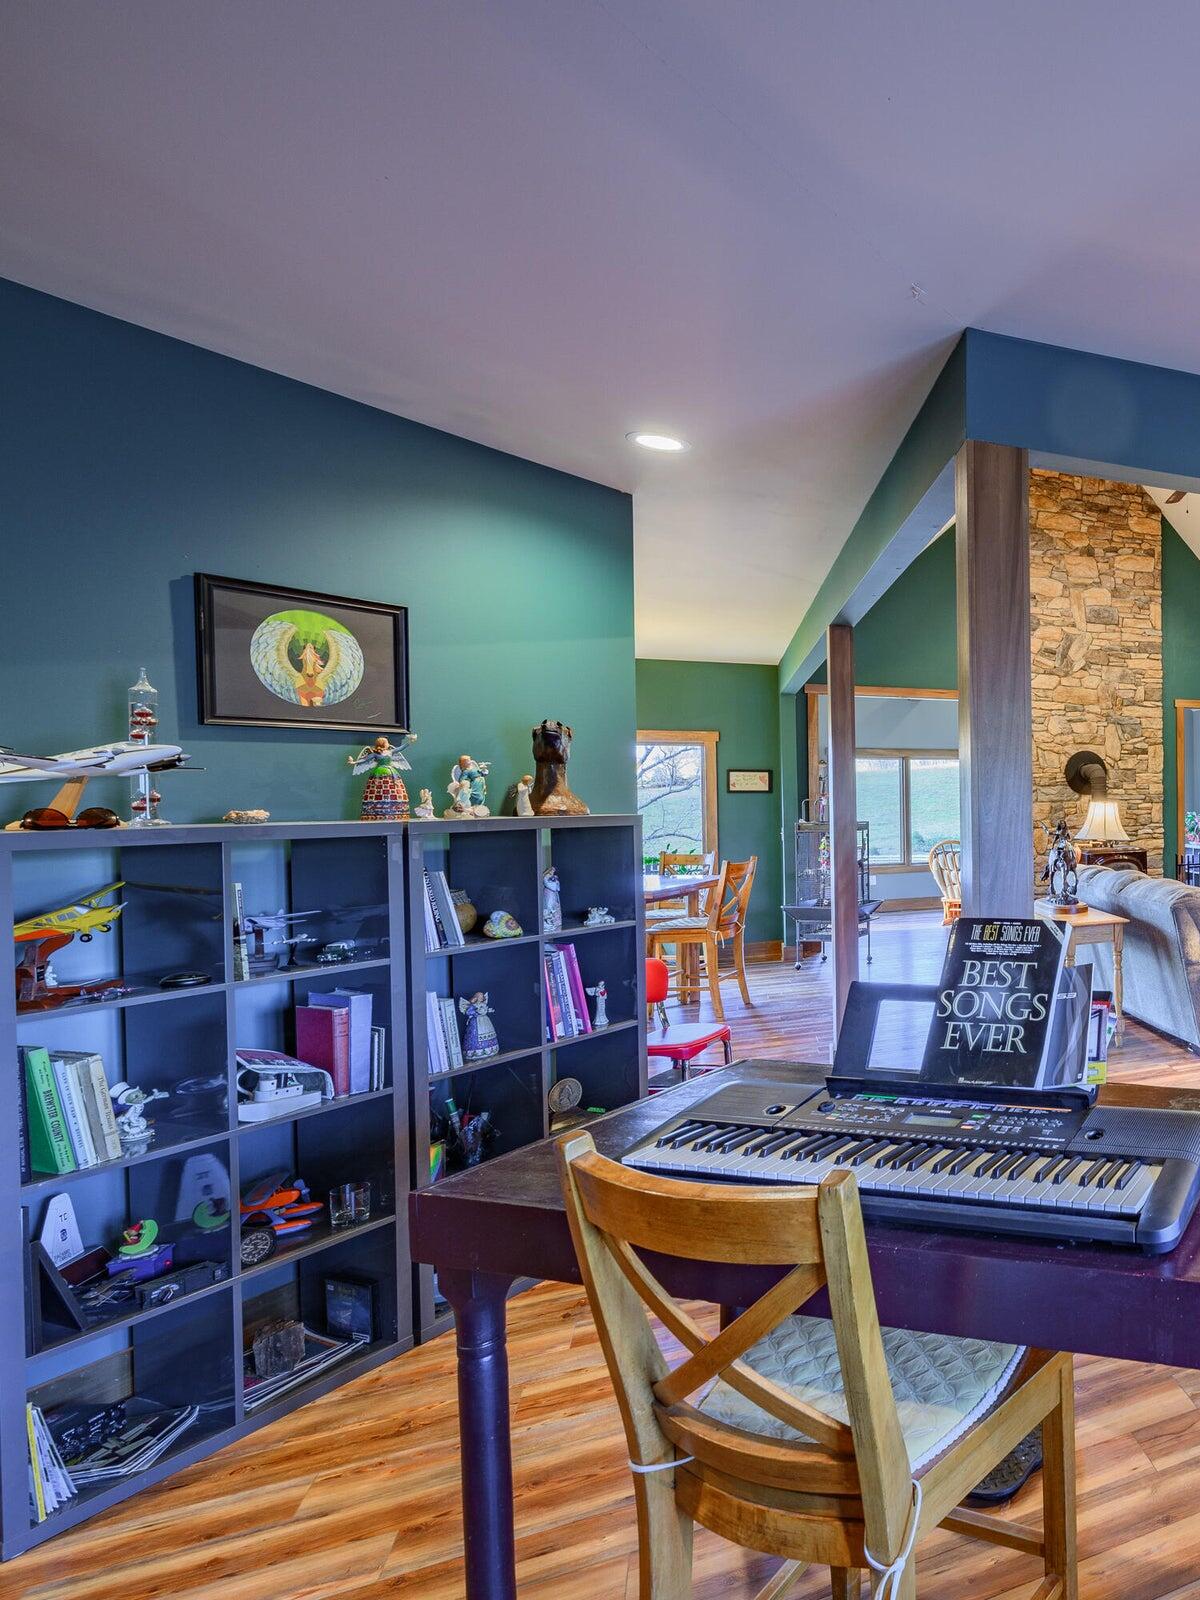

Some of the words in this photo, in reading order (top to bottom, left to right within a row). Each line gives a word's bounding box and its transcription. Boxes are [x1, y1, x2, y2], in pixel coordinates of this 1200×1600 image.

[971, 924, 983, 940] THE
[983, 924, 1000, 941] BEST
[1000, 925, 1023, 942] SONGS
[1023, 926, 1041, 943] EVER
[958, 959, 1038, 989] BEST
[936, 989, 1049, 1021] SONGS
[940, 1021, 1027, 1054] EVER
[42, 1089, 58, 1119] BREWSTER
[50, 1119, 64, 1143] COUNTY
